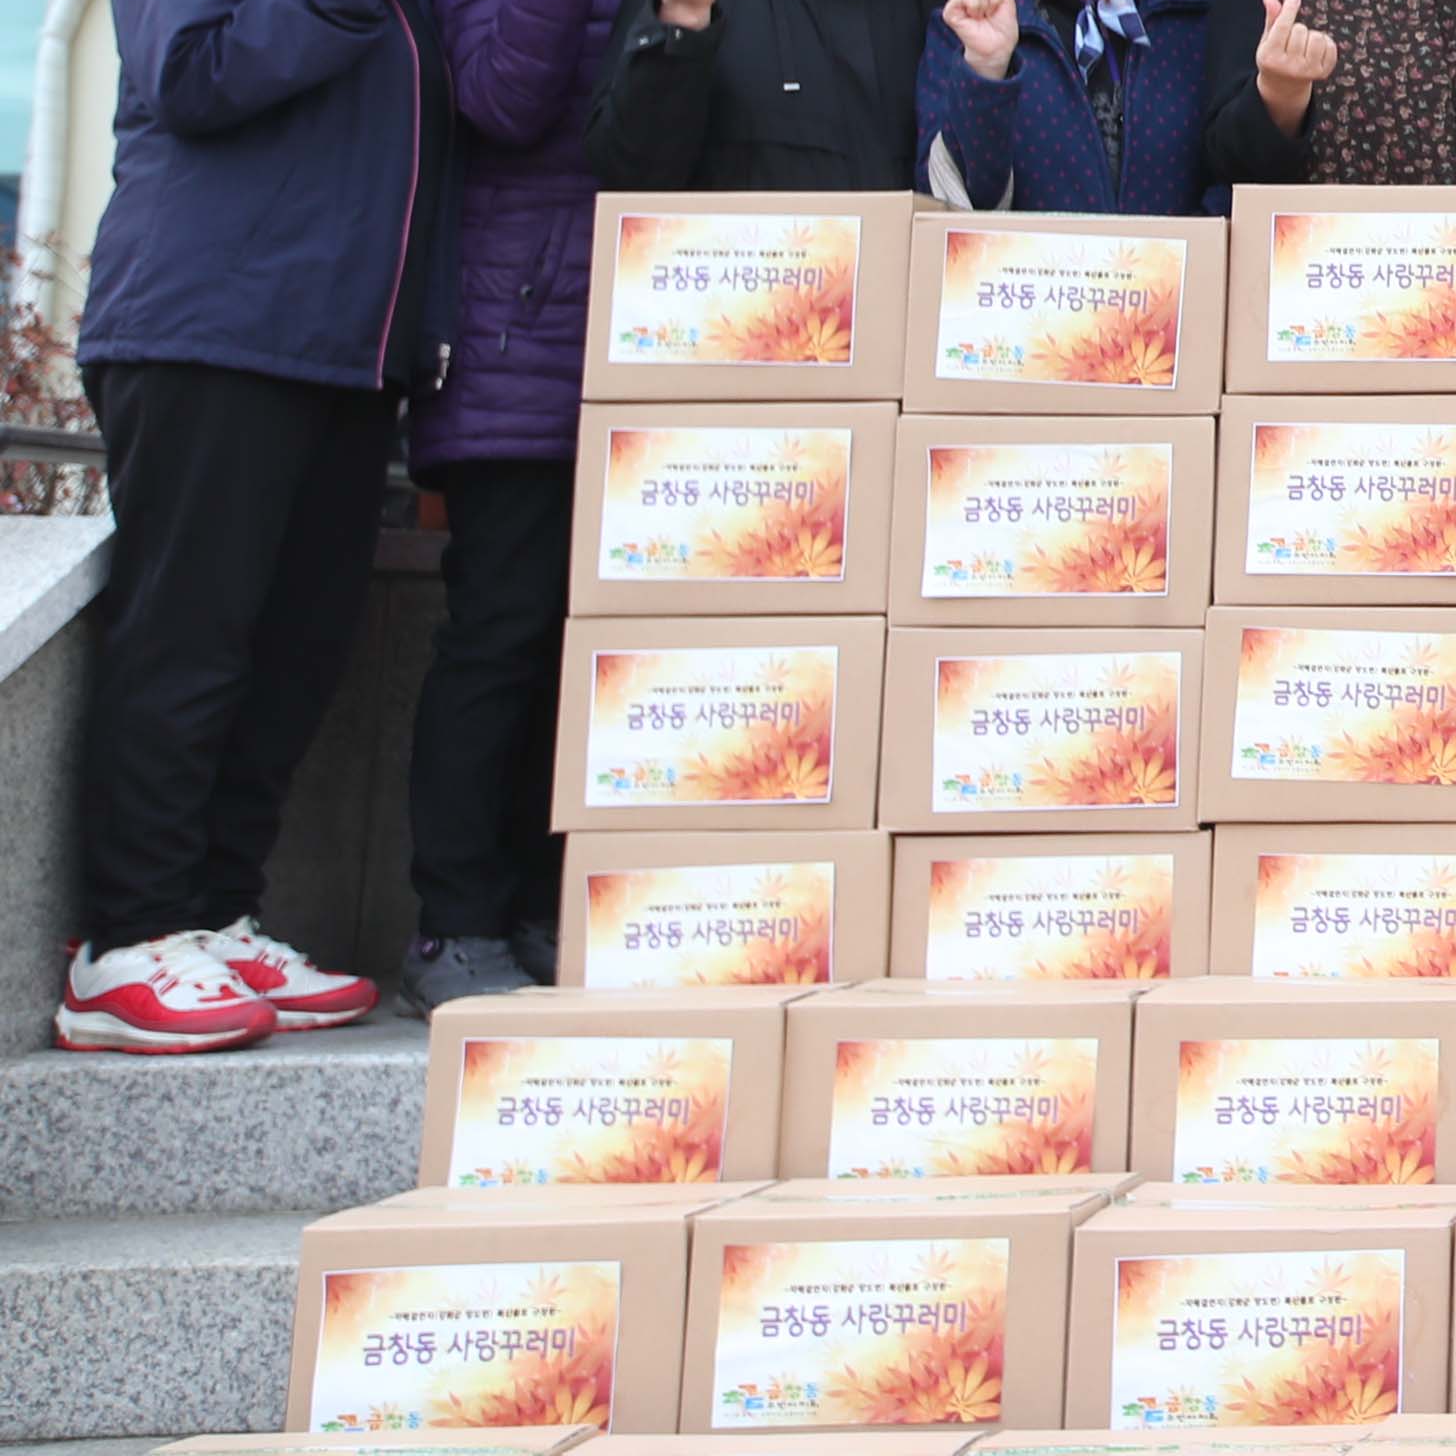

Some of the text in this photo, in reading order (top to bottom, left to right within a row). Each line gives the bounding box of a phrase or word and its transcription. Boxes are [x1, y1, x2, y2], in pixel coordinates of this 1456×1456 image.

[649, 265, 824, 294] 금창동 사랑꾸러미
[1304, 263, 1366, 289] 금창동
[975, 281, 1149, 316] 금창동 사랑꾸러미
[638, 480, 816, 507] 금창동 사랑꾸러미
[1285, 475, 1348, 502] 금창동
[962, 496, 1137, 523] 금창동 사랑꾸러미
[1271, 679, 1447, 713] 금창동 사랑꾸러미
[625, 702, 801, 731] 금창동 사랑꾸러미
[970, 706, 1146, 736] 금창동 사랑꾸러미
[622, 917, 800, 950] 금창동 사랑꾸러미
[965, 909, 1140, 938] 금창동 사랑꾸러미
[1289, 906, 1352, 934] 금창동
[494, 1096, 691, 1128] 금창동 사랑꾸러미
[869, 1096, 1060, 1126] 금창동 사랑꾸러미
[1213, 1096, 1403, 1125] 금창동 사랑꾸러미
[757, 1302, 968, 1338] 금창동 사랑꾸러미
[1156, 1315, 1363, 1351] 금창동 사랑꾸러미
[360, 1327, 577, 1367] 금창동 사랑꾸러미
